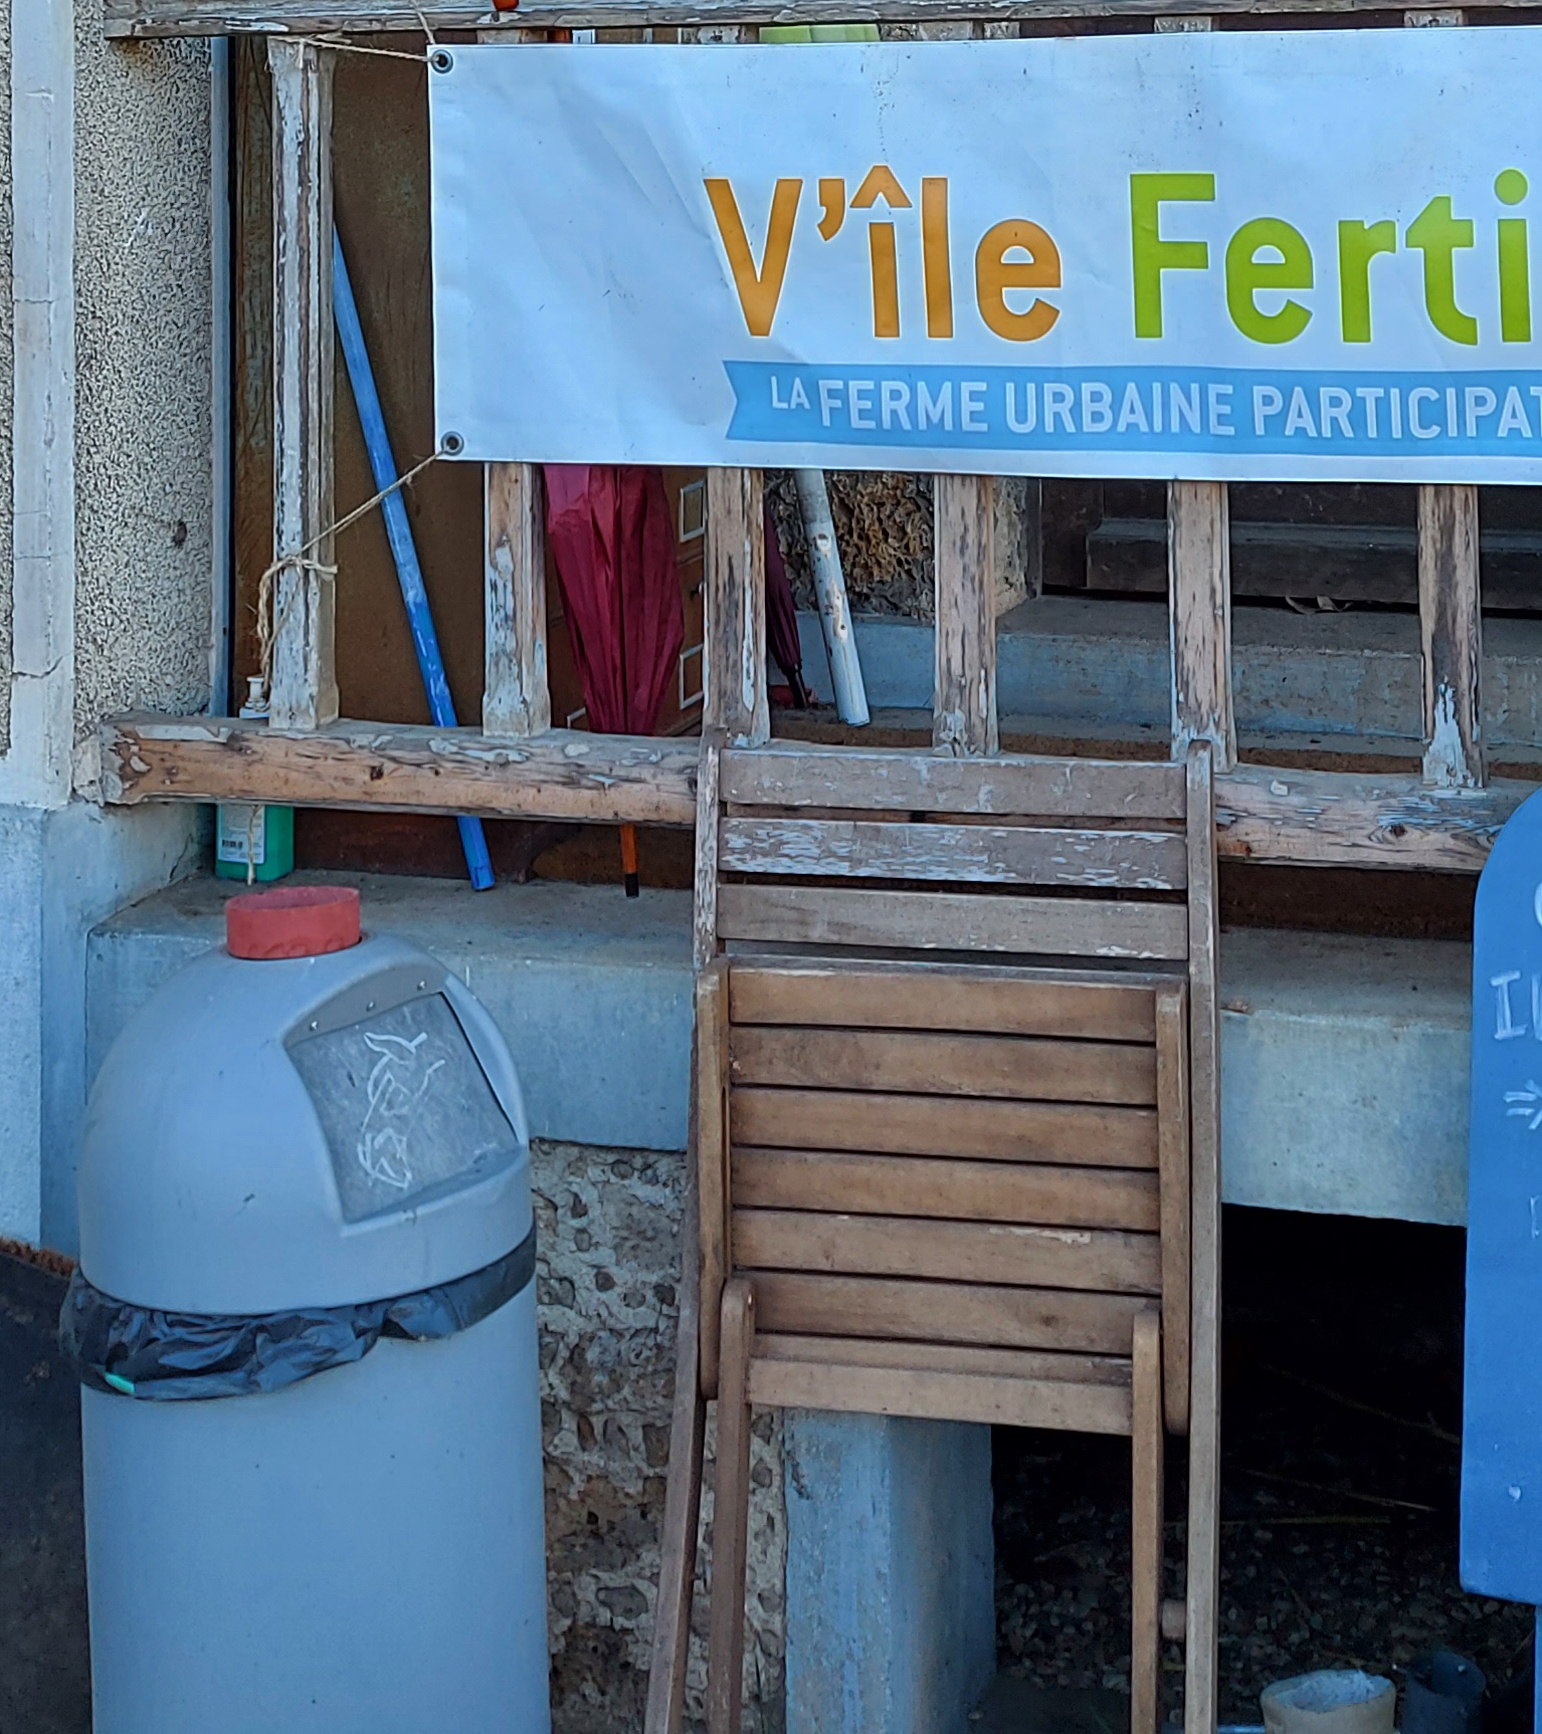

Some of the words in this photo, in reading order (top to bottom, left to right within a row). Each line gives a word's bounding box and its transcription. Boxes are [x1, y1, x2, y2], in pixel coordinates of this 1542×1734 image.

[770, 375, 810, 410] LA
[817, 378, 989, 432] FERME
[1005, 381, 1235, 436] URBAINE
